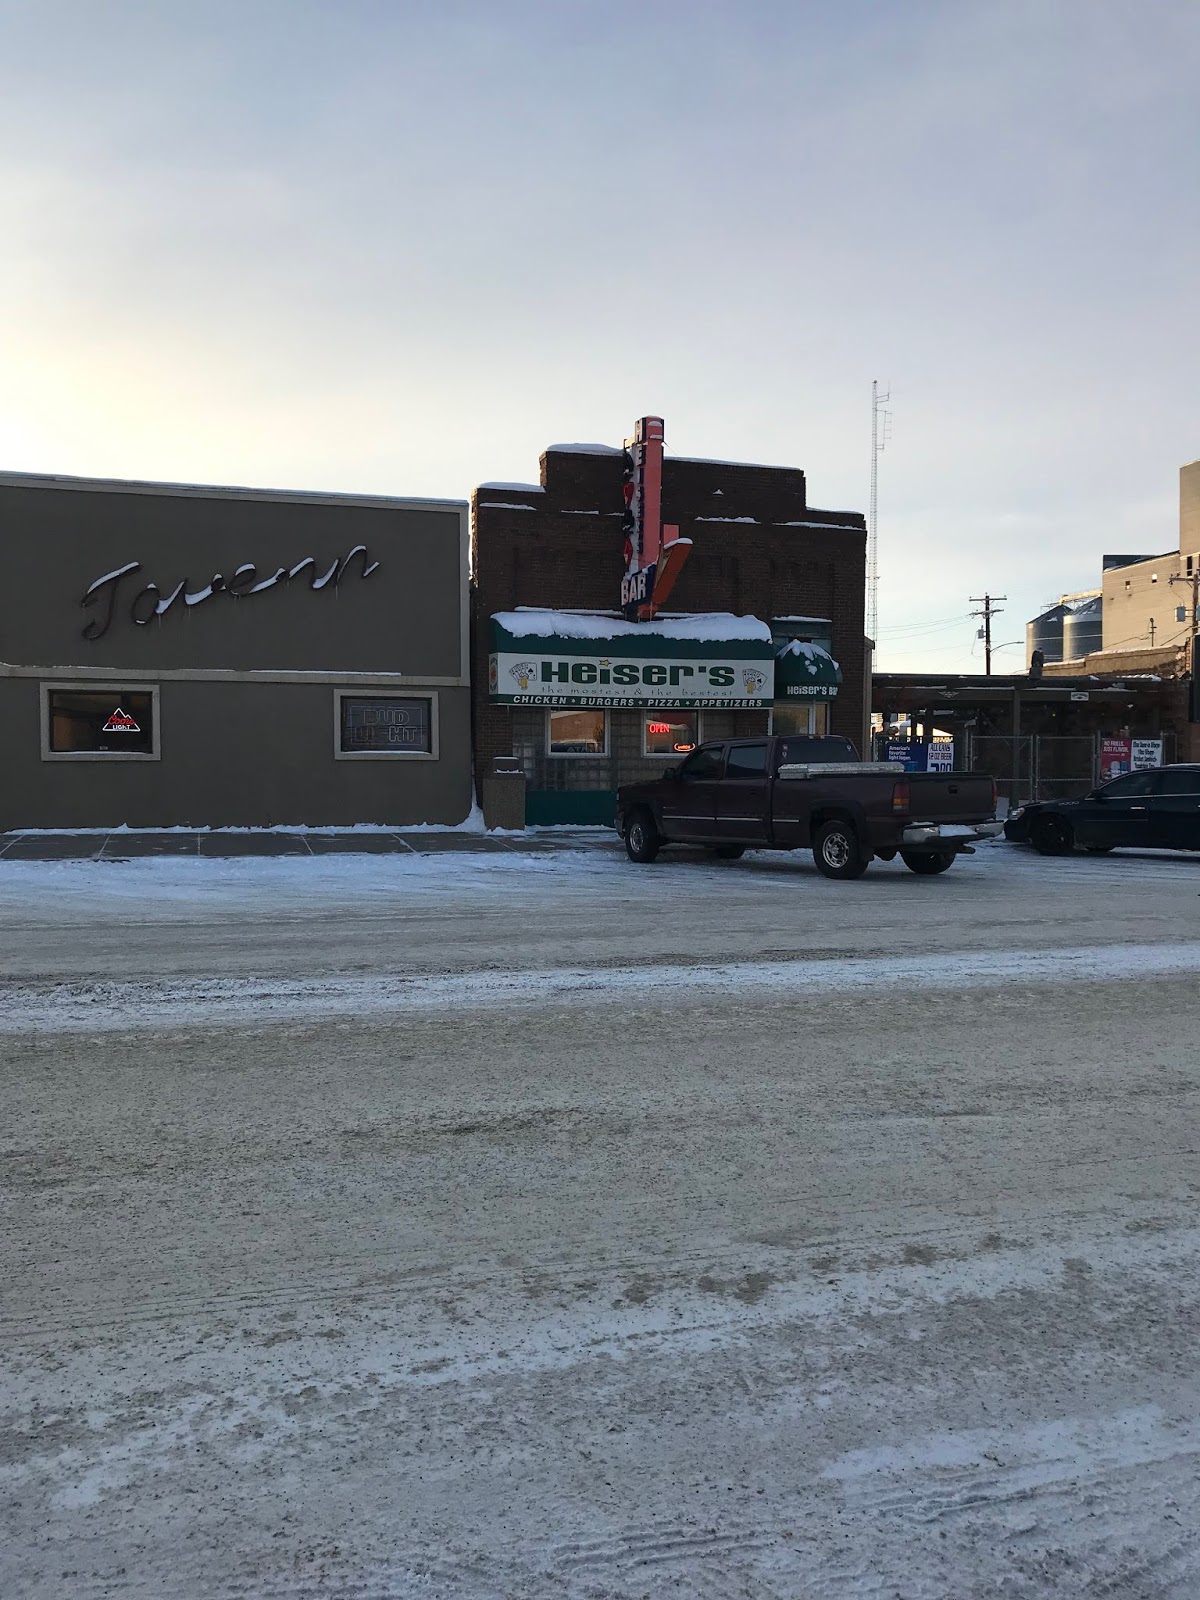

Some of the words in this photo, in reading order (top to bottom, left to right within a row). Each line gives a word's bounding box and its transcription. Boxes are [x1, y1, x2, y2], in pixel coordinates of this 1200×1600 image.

[80, 544, 381, 642] Tavern
[621, 573, 647, 606] BAR
[541, 659, 735, 688] Heiser's
[541, 685, 564, 694] the
[570, 687, 628, 697] mostest
[633, 687, 643, 697] &
[651, 688, 673, 697] the
[681, 688, 735, 698] bestest
[513, 695, 567, 705] CHICKEN
[580, 697, 635, 707] BURGERS
[647, 699, 681, 707] PIZZA
[694, 699, 762, 708] APPETIZERS
[109, 714, 135, 725] Coors
[363, 709, 410, 726] BUD
[649, 723, 670, 734] OPEN
